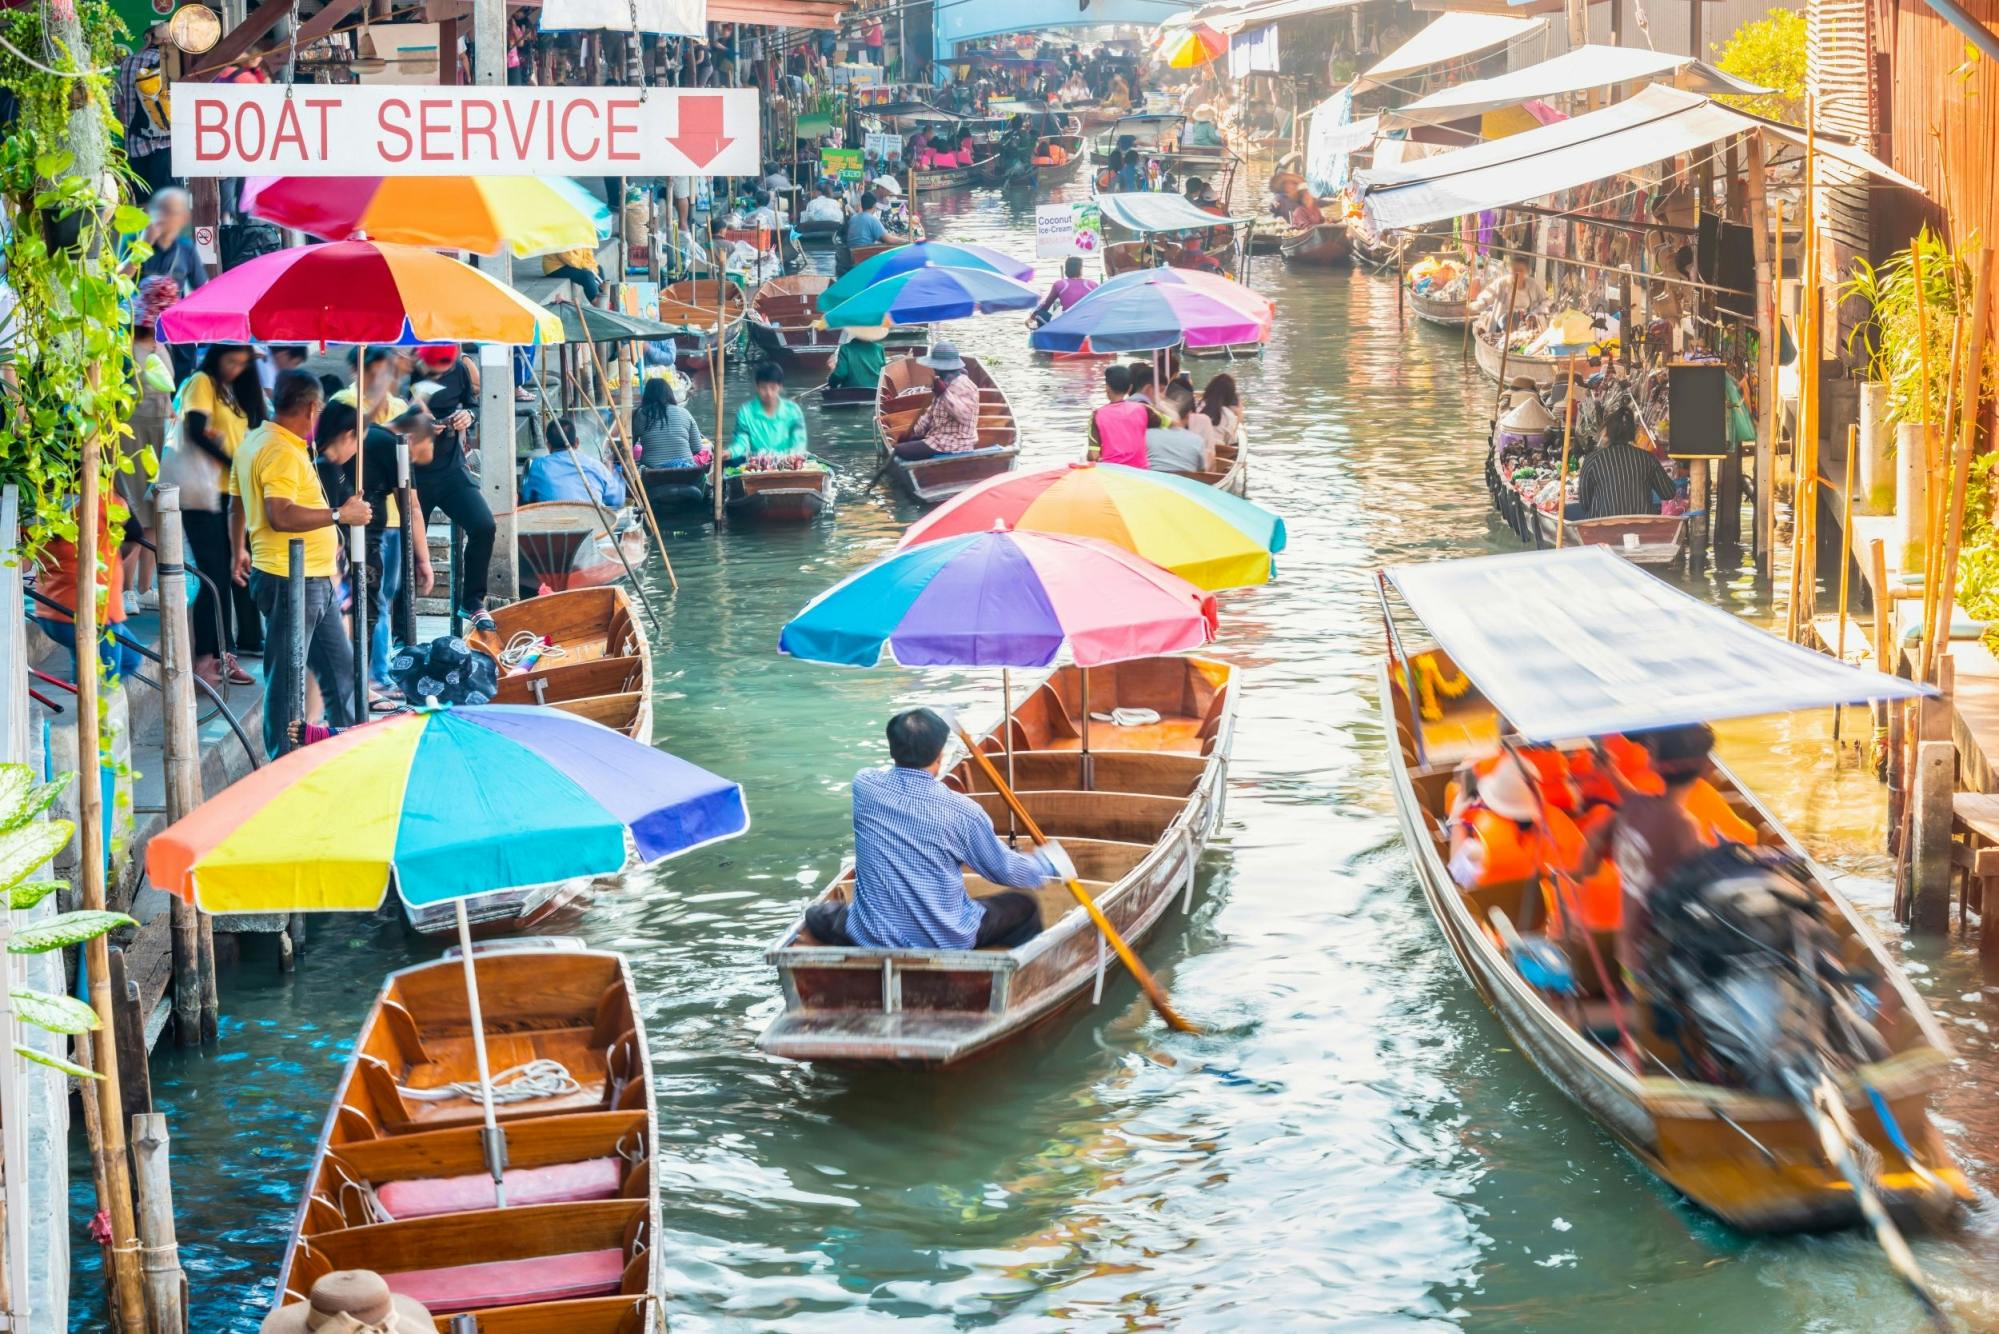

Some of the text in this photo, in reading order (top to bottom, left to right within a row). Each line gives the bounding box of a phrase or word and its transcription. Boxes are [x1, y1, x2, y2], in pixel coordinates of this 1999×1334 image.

[195, 98, 641, 162] BOAT SERVICE
[1038, 215, 1072, 226] Coconut
[1038, 225, 1072, 234] Ice-Cream
